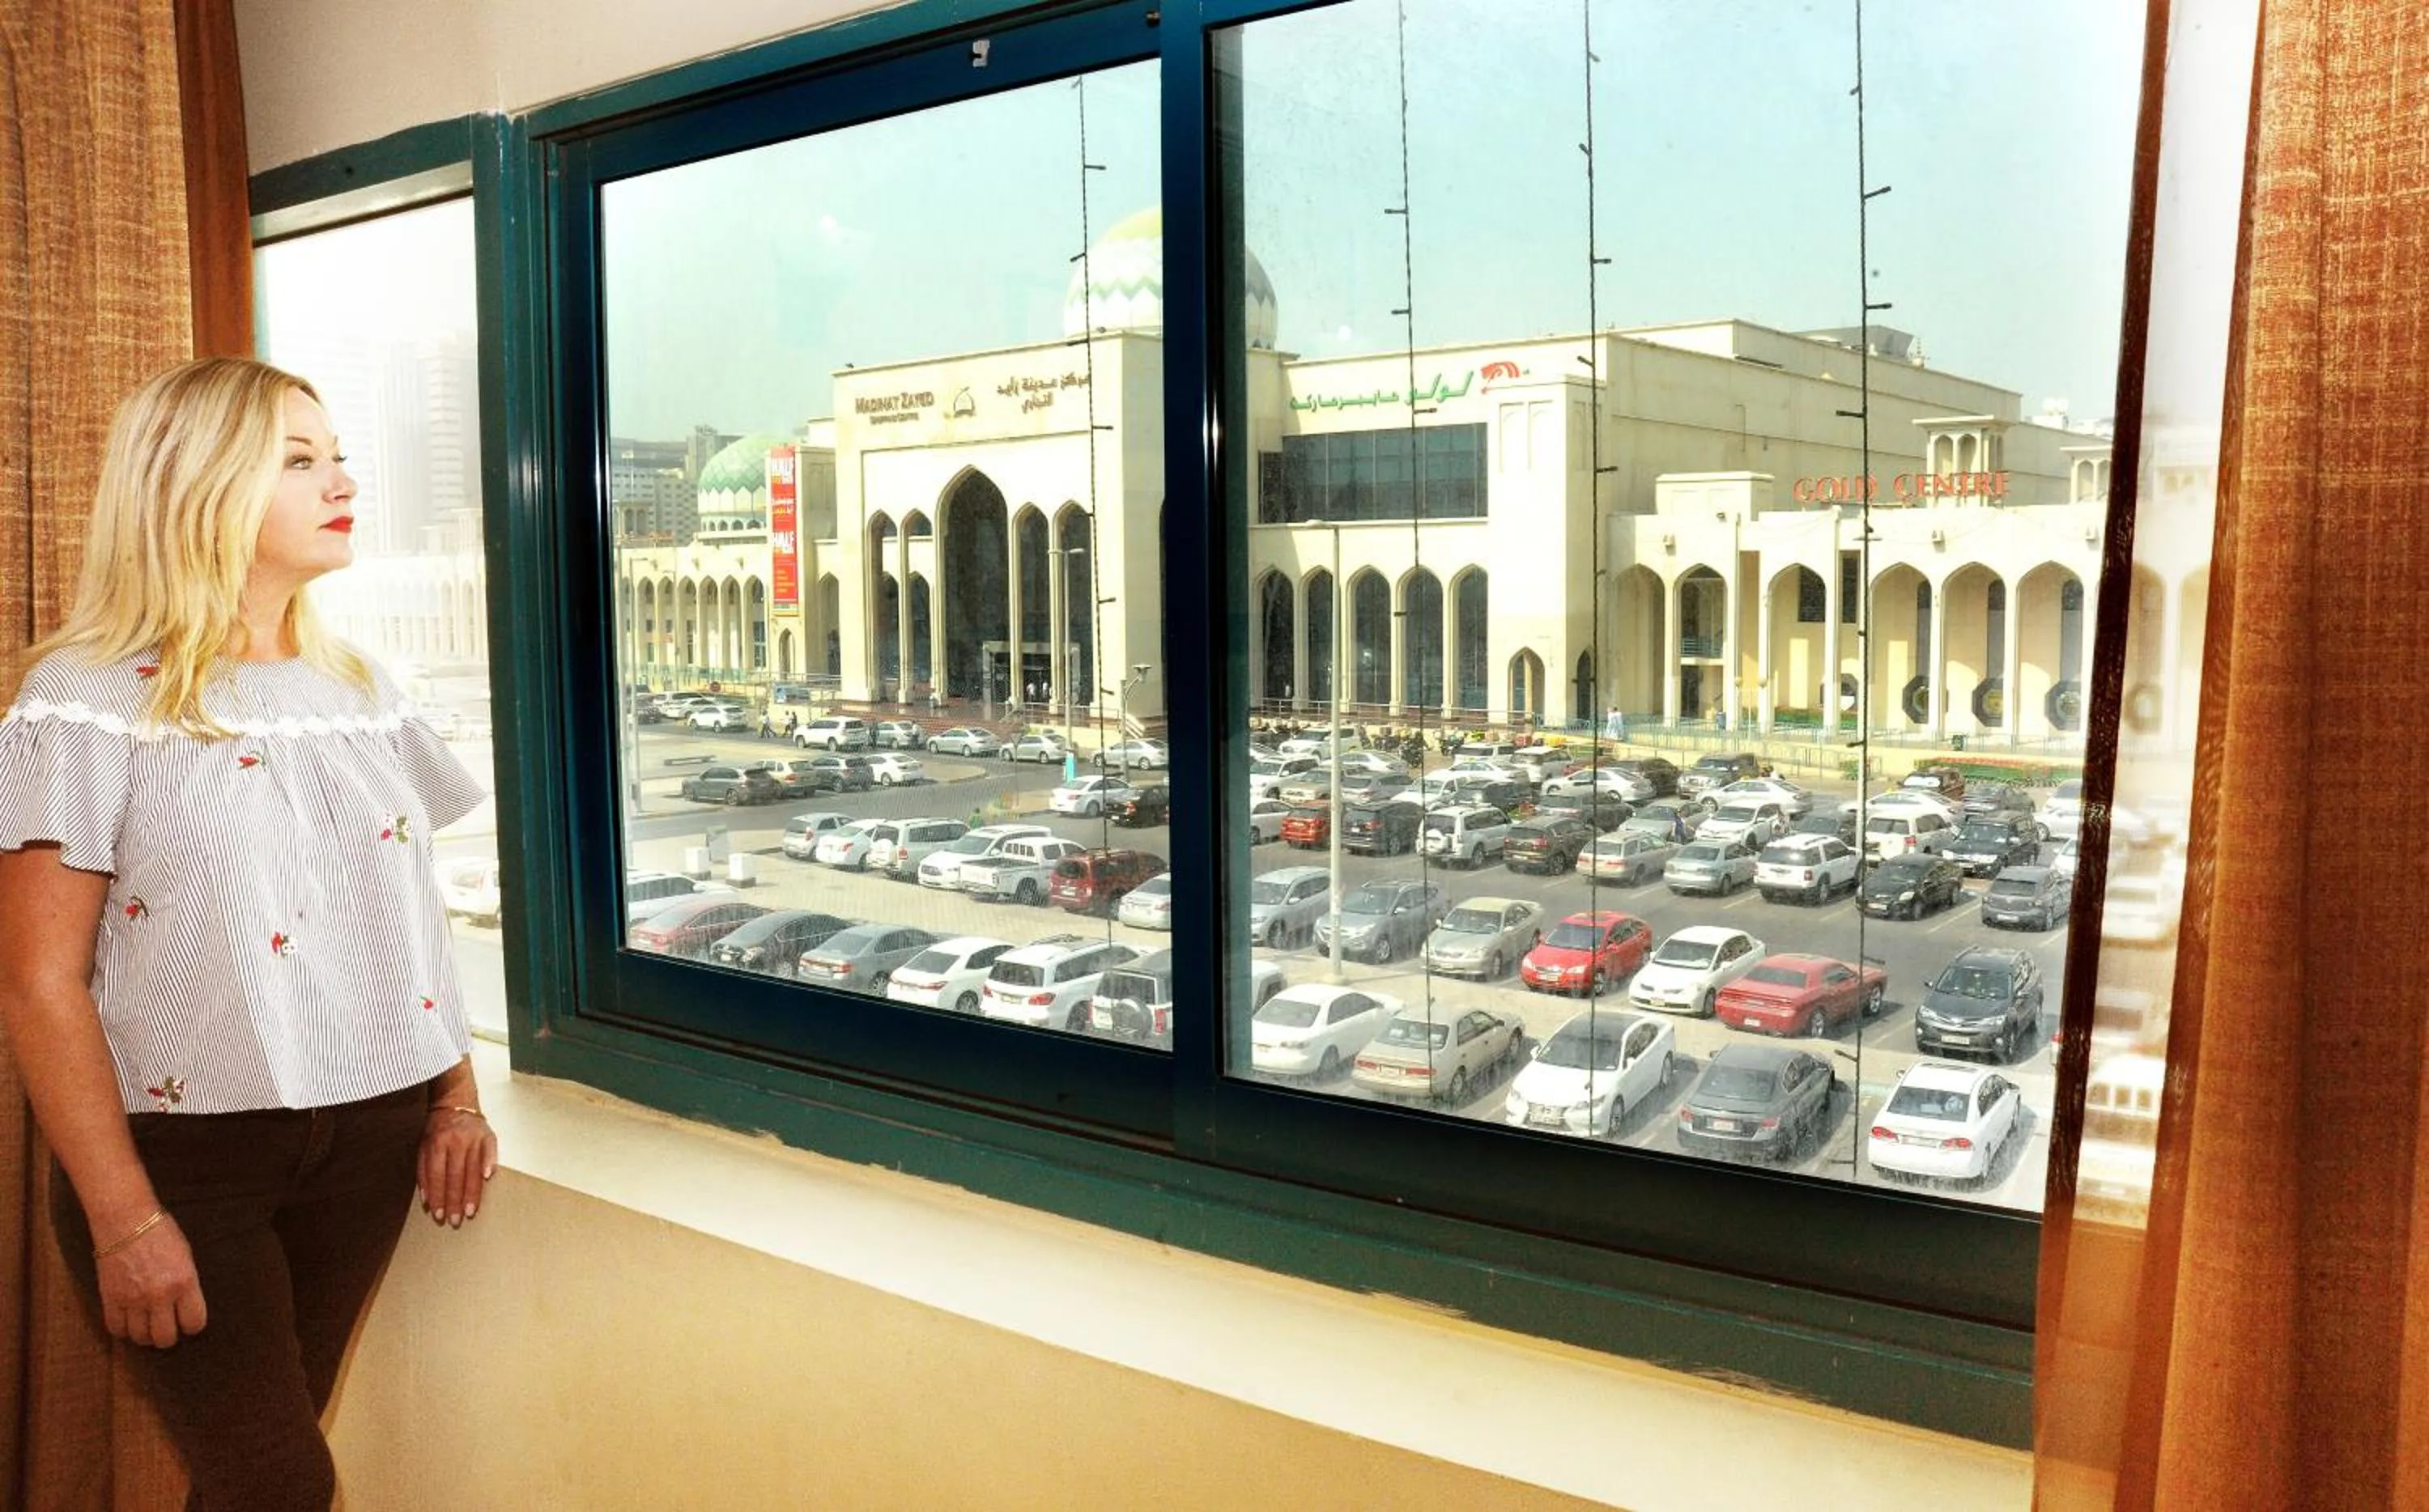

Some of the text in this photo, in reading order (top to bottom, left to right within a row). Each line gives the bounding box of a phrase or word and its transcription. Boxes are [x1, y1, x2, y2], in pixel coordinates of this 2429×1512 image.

[855, 391, 934, 414] MADINAT ZAYED
[1793, 468, 2011, 503] GOLD CENTRE
